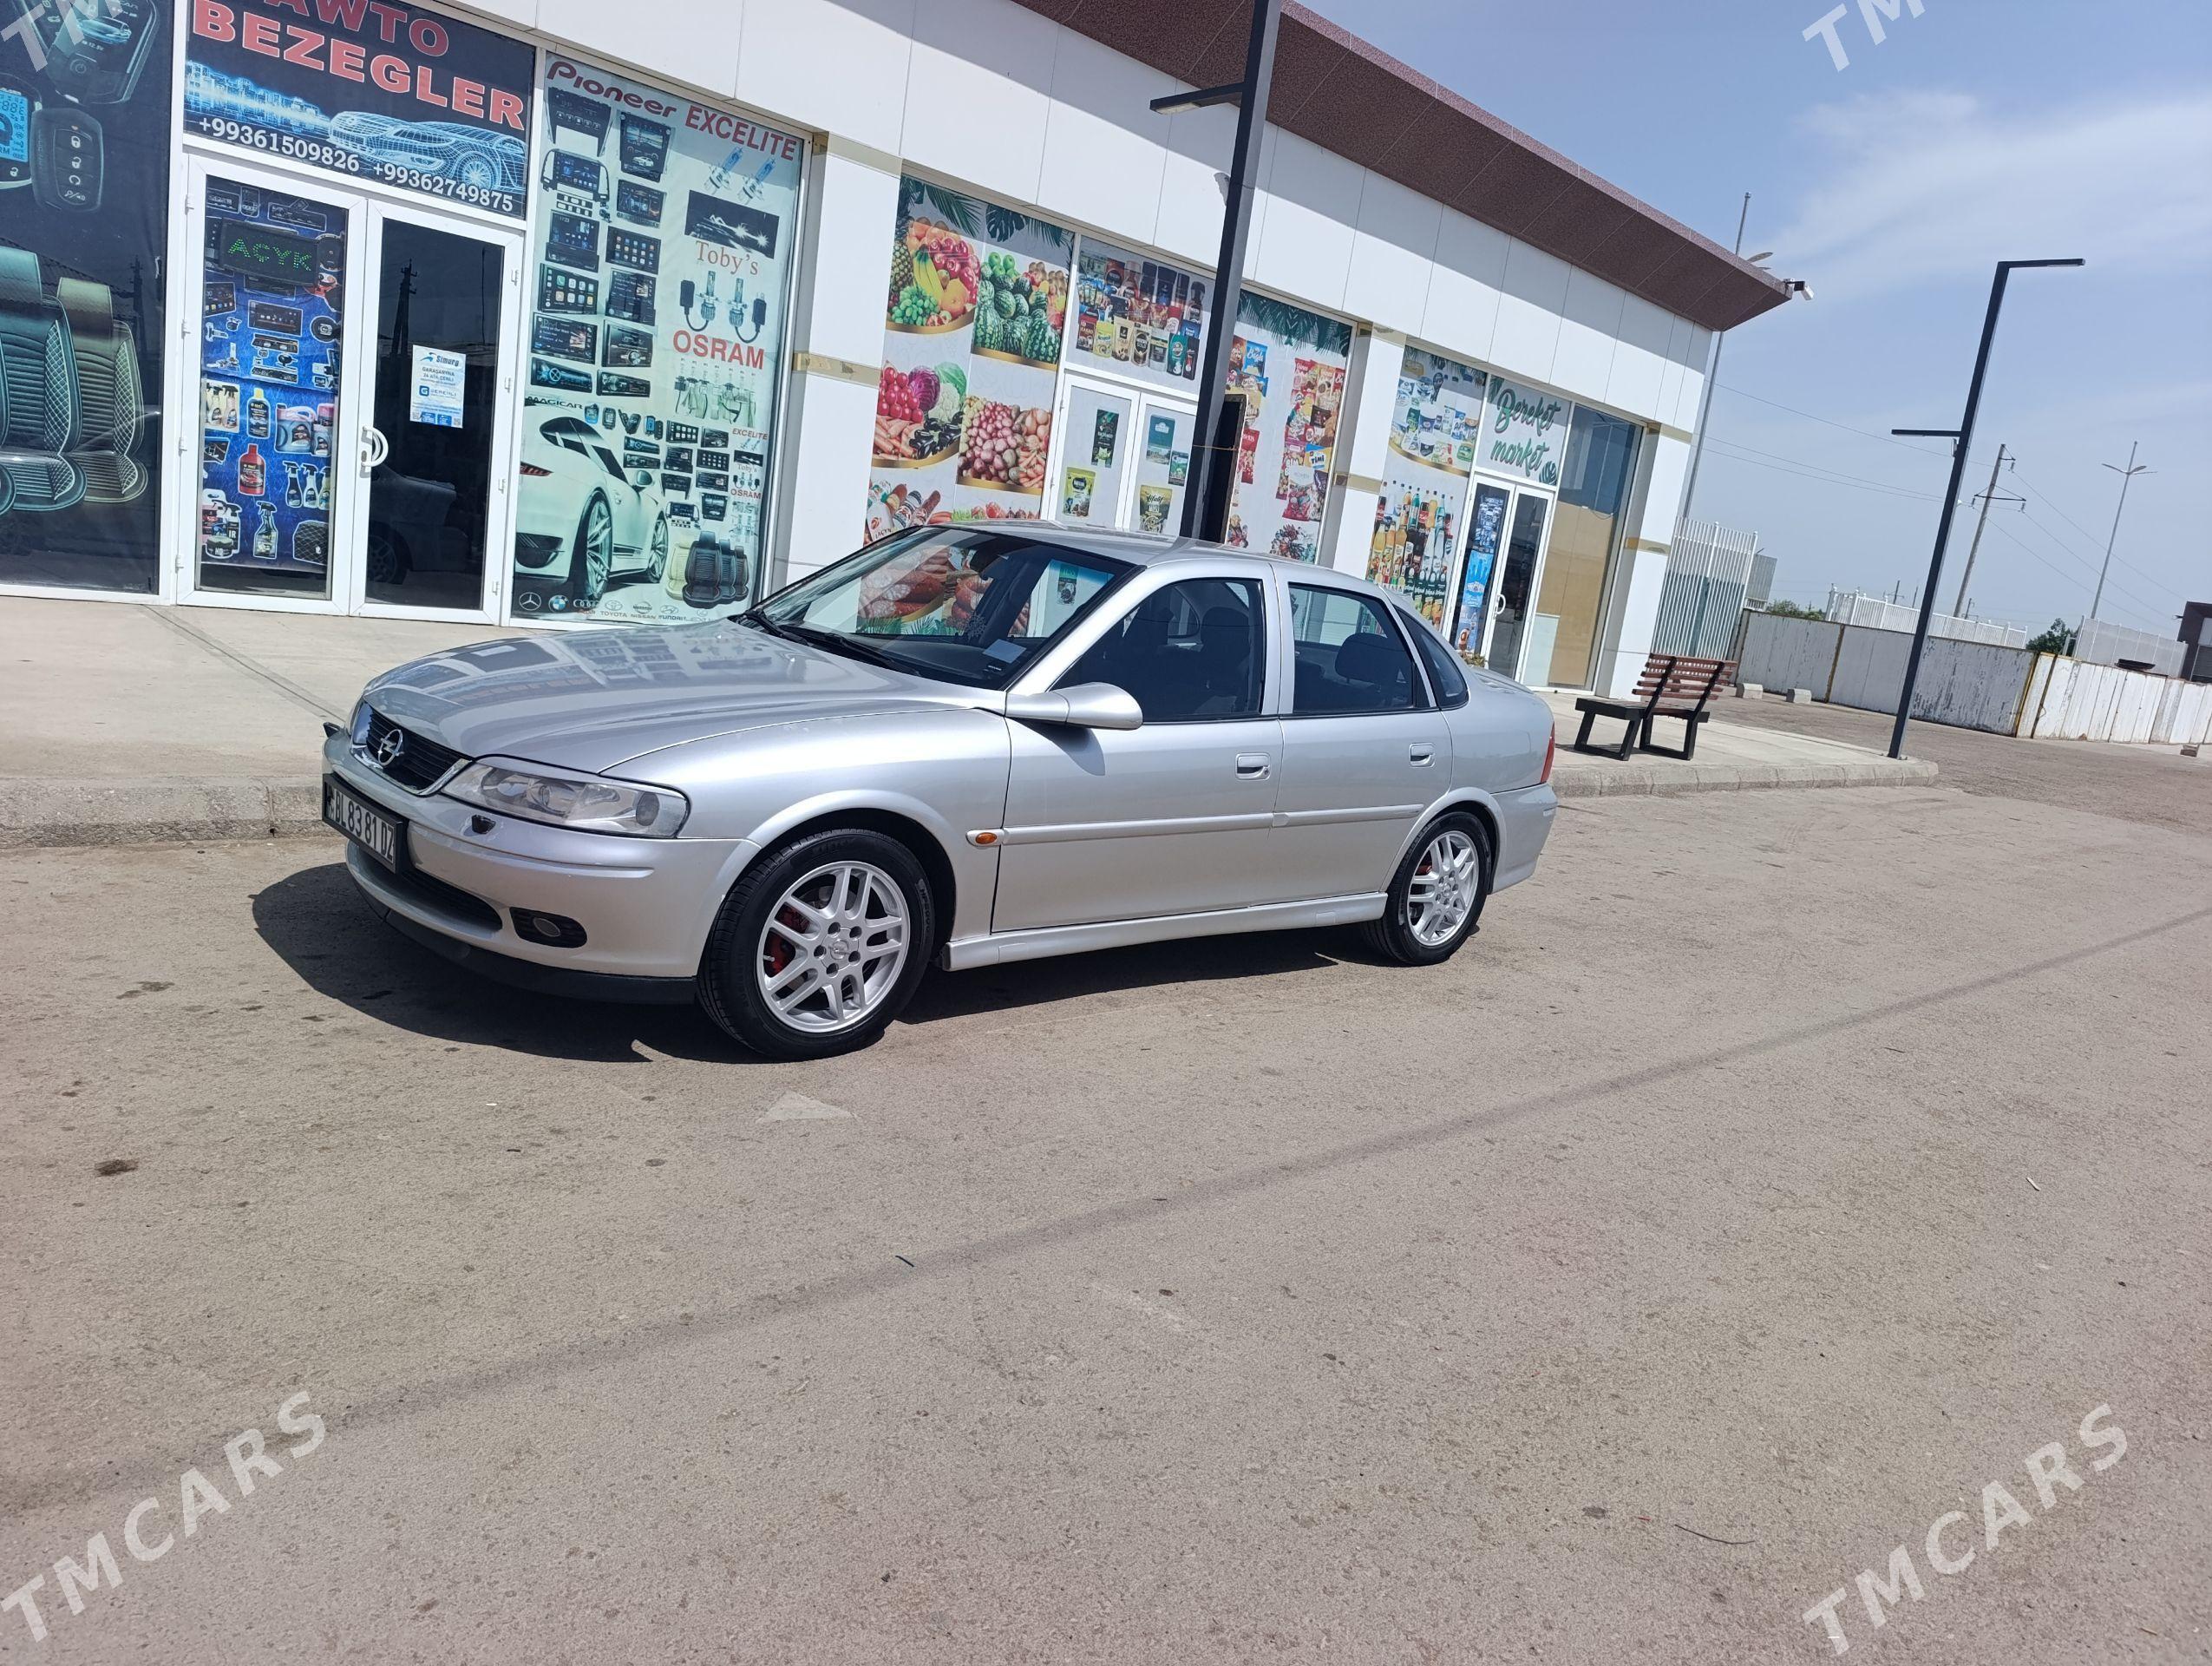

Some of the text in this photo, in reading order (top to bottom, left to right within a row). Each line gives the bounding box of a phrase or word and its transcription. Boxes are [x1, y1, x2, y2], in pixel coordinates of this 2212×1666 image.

[192, 0, 525, 131] BEZEGLER
[546, 60, 677, 119] Pioneer
[199, 115, 360, 173] +99361509826
[684, 104, 798, 161] EXCELITE
[373, 161, 514, 213] +99362749875
[696, 240, 759, 276] Toby's
[673, 330, 765, 371] OSRAM
[527, 396, 584, 410] MAGICAR
[1494, 388, 1561, 436] Bereket
[732, 428, 769, 440] EXCELITE
[1489, 438, 1550, 477] market
[730, 488, 762, 500] OSRAM
[336, 789, 346, 828] BL
[348, 800, 362, 838] 83
[365, 811, 377, 850] 81
[381, 821, 394, 862] DZ
